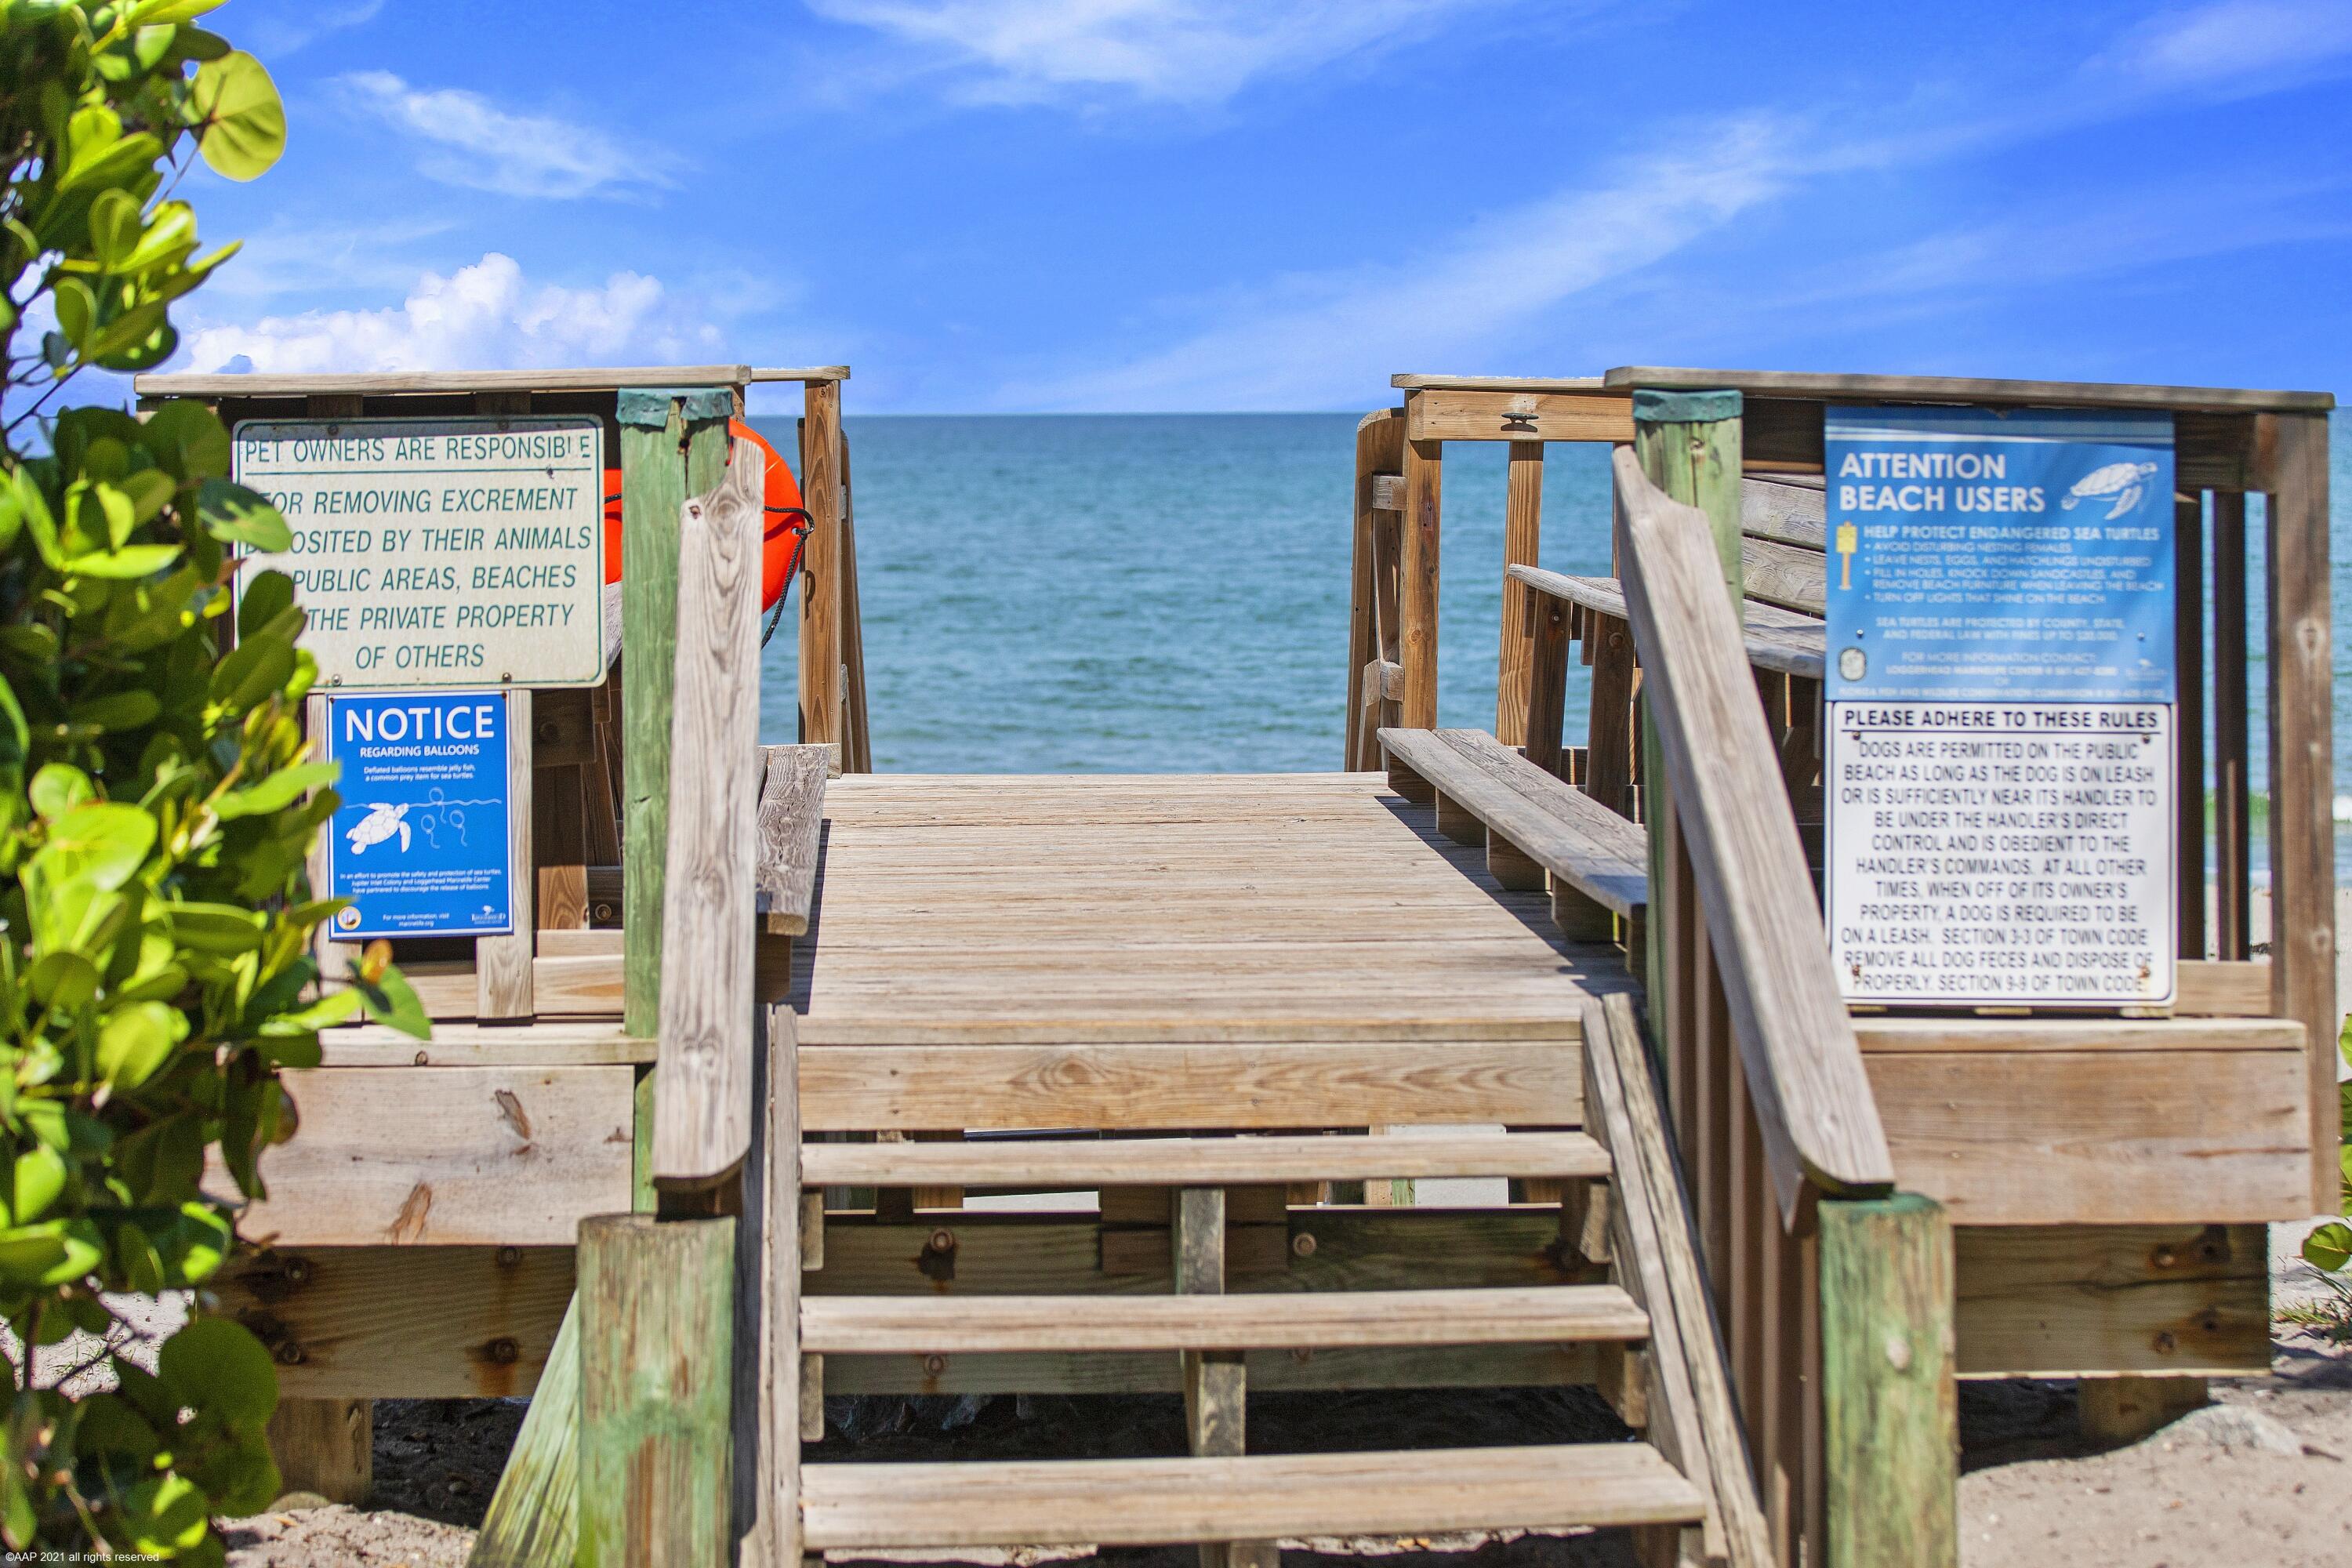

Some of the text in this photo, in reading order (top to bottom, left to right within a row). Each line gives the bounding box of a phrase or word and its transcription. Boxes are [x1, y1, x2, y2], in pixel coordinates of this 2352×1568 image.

[246, 439, 281, 463] PET
[294, 438, 385, 463] OWNERS
[395, 437, 435, 461] ARE
[1838, 452, 2005, 479] ATTENTION
[259, 488, 579, 515] OR REMOVING EXCREMENT
[1839, 485, 2045, 512] BEACH USERS
[245, 526, 591, 554] OSITED BY THEIR ANIMALS
[1864, 525, 2160, 541] HELP PROTECT ENDANGERED SEA TURTLES
[293, 564, 577, 594] PUBLIC AREAS, BEACHES
[307, 604, 575, 631] THE PRIVATE PROPERTY
[356, 644, 485, 669] OF OTHERS
[345, 705, 495, 742] NOTICE
[1845, 710, 2158, 728] PLEASE ADHERE TO THESE RULES
[360, 744, 480, 758] REGARDING BALLOONS
[1860, 742, 2139, 760] DOGS ARE PERMITTED ON THE PUBLIC
[1845, 764, 2154, 783] BEACH AS LONG AS THE DOG IS ON LEASH
[1842, 788, 2156, 807] OR IS SUFFICIENTLY NEAR ITS HANDLER TO
[1875, 811, 1893, 828] BE
[1899, 811, 1950, 828] UNDER
[1955, 811, 1982, 829] THE
[2075, 812, 2128, 829] DIRECT
[1872, 834, 2130, 852] CONTROL AND IS OBEDIENT TO THE
[2043, 859, 2060, 875] AT
[2066, 859, 2092, 875] ALL
[2096, 859, 2147, 876] OTHER
[1928, 881, 1971, 897] WHEN
[1976, 881, 2004, 898] OFF
[2009, 882, 2027, 898] OF
[2033, 882, 2055, 898] ITS
[1946, 906, 1955, 920] A
[1961, 905, 1991, 921] DOG
[1997, 906, 2009, 921] IS
[2015, 906, 2089, 922] REQUIRED
[2095, 906, 2114, 922] TO
[2119, 906, 2138, 922] BE
[1842, 927, 1862, 943] ON
[1867, 928, 1876, 942] A
[1943, 928, 2005, 944] SECTION
[2035, 929, 2054, 945] OF
[2060, 929, 2103, 945] TOWN
[1844, 951, 2153, 968] REMOVE ALL DOG FECES AND DISPOSE OF
[1939, 975, 2001, 991] SECTION
[2032, 975, 2050, 992] OF
[2057, 975, 2100, 992] TOWN
